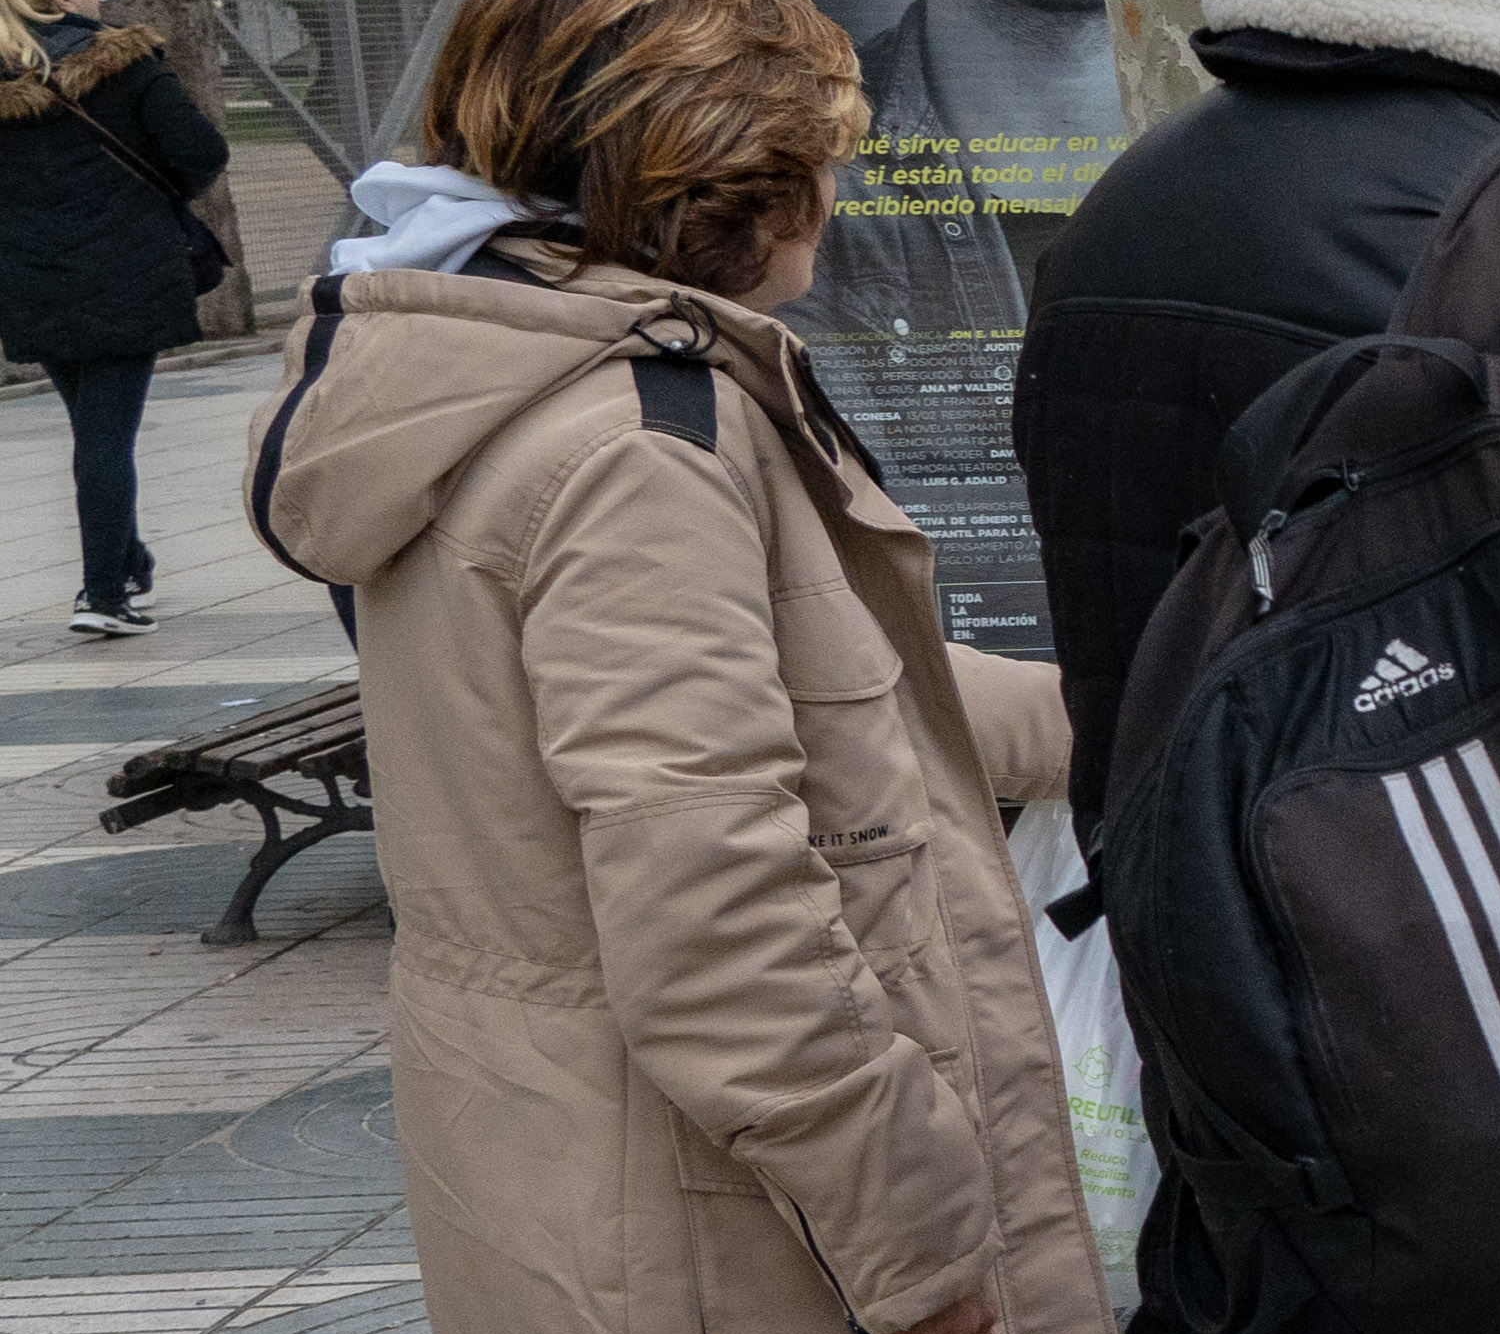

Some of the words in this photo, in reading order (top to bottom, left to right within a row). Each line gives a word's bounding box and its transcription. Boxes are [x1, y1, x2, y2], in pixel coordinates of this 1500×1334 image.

[896, 133, 961, 155] sirve
[968, 132, 1060, 154] educar
[1067, 135, 1098, 152] en
[864, 164, 886, 186] si
[892, 163, 963, 185] están
[970, 163, 1034, 184] todo
[1042, 162, 1066, 183] el
[833, 194, 975, 216] recibiendo
[982, 192, 1081, 217] mensaj
[919, 383, 946, 393] ANA
[922, 475, 948, 486] LUIS
[949, 515, 967, 526] DE
[969, 513, 1019, 525] GÉNERO
[977, 528, 1010, 538] PARA
[1011, 527, 1028, 537] LA
[937, 555, 973, 566] SIGLO
[948, 592, 984, 604] TODA
[949, 605, 968, 616] LA
[950, 612, 1038, 629] INFORMACIÓN
[953, 629, 976, 641] EN:
[1353, 662, 1457, 713] adidas
[1068, 1095, 1145, 1126] REUTIL
[1083, 1183, 1136, 1198] einventa
